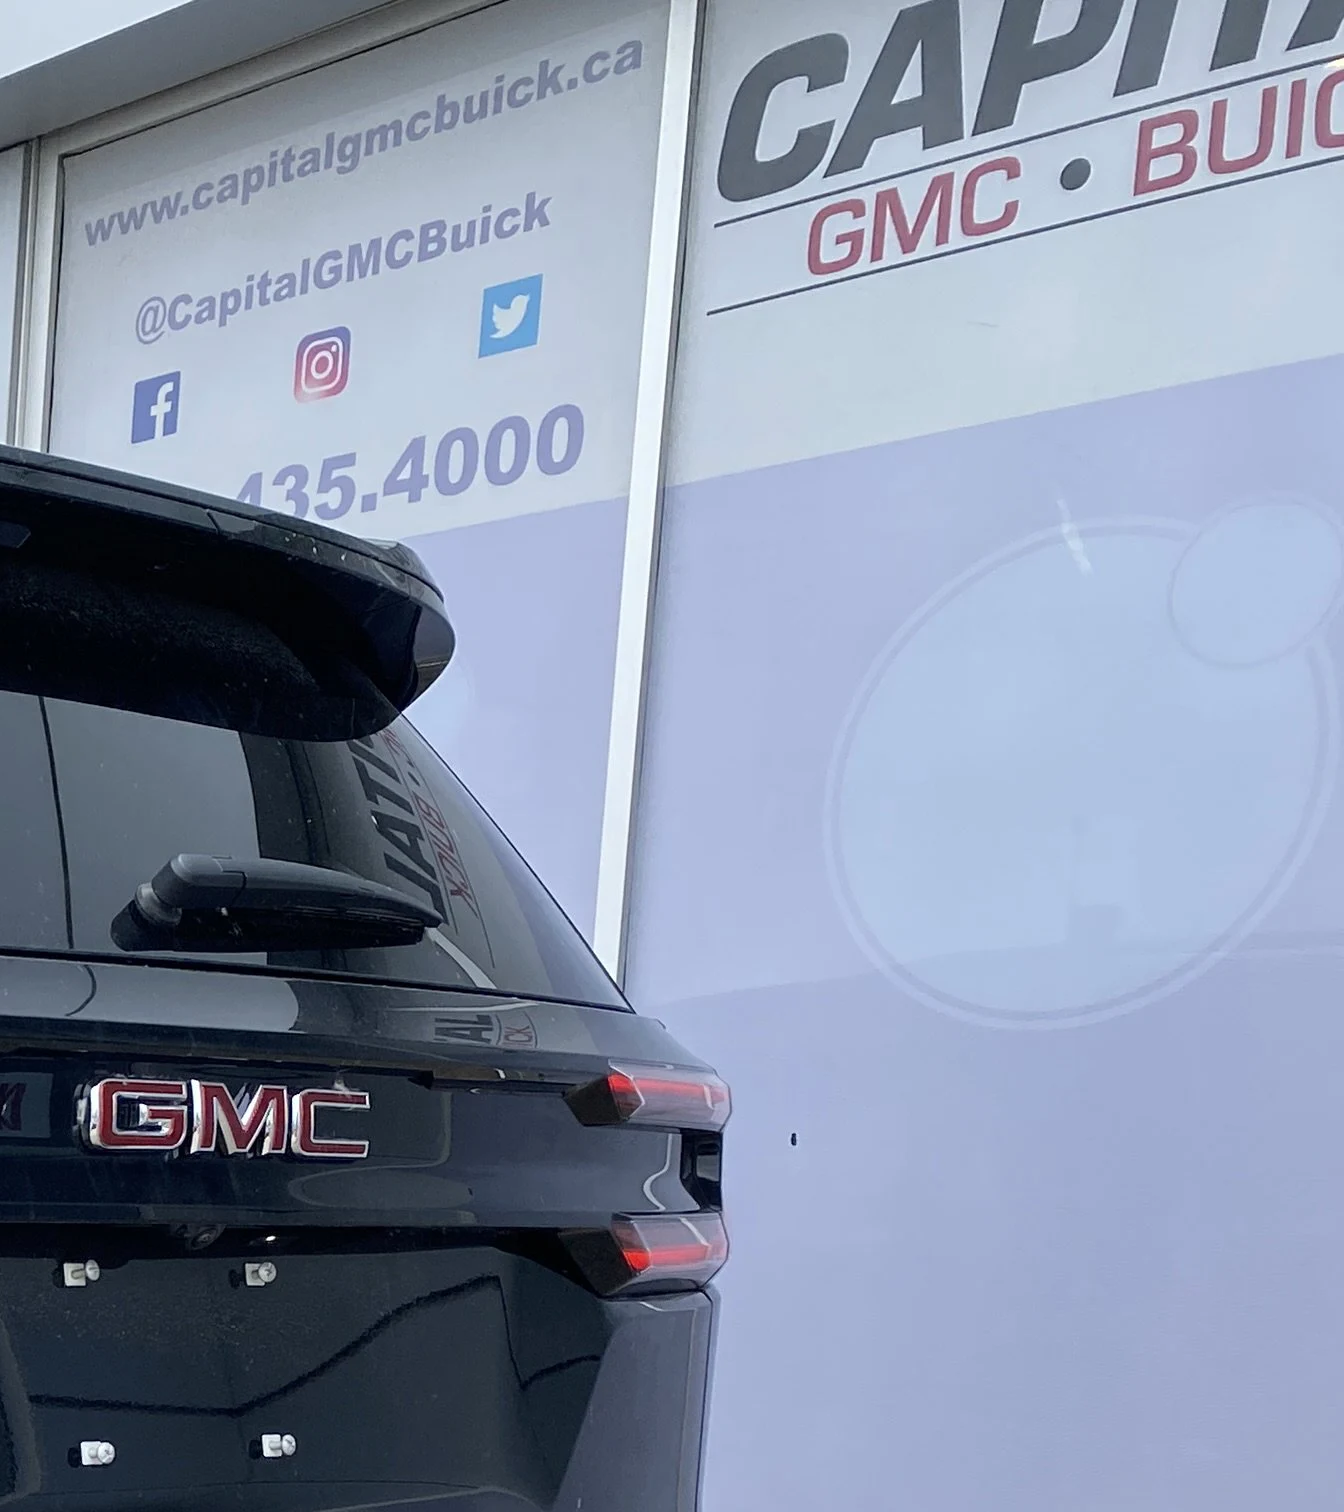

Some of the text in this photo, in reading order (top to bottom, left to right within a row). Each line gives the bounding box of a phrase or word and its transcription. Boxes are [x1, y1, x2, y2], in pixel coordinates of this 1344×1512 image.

[84, 39, 644, 246] www.capitalgmcbuick.ca
[135, 191, 552, 345] @CapitalGMCBuick
[807, 156, 1021, 276] GMC
[90, 1077, 370, 1157] GMC
